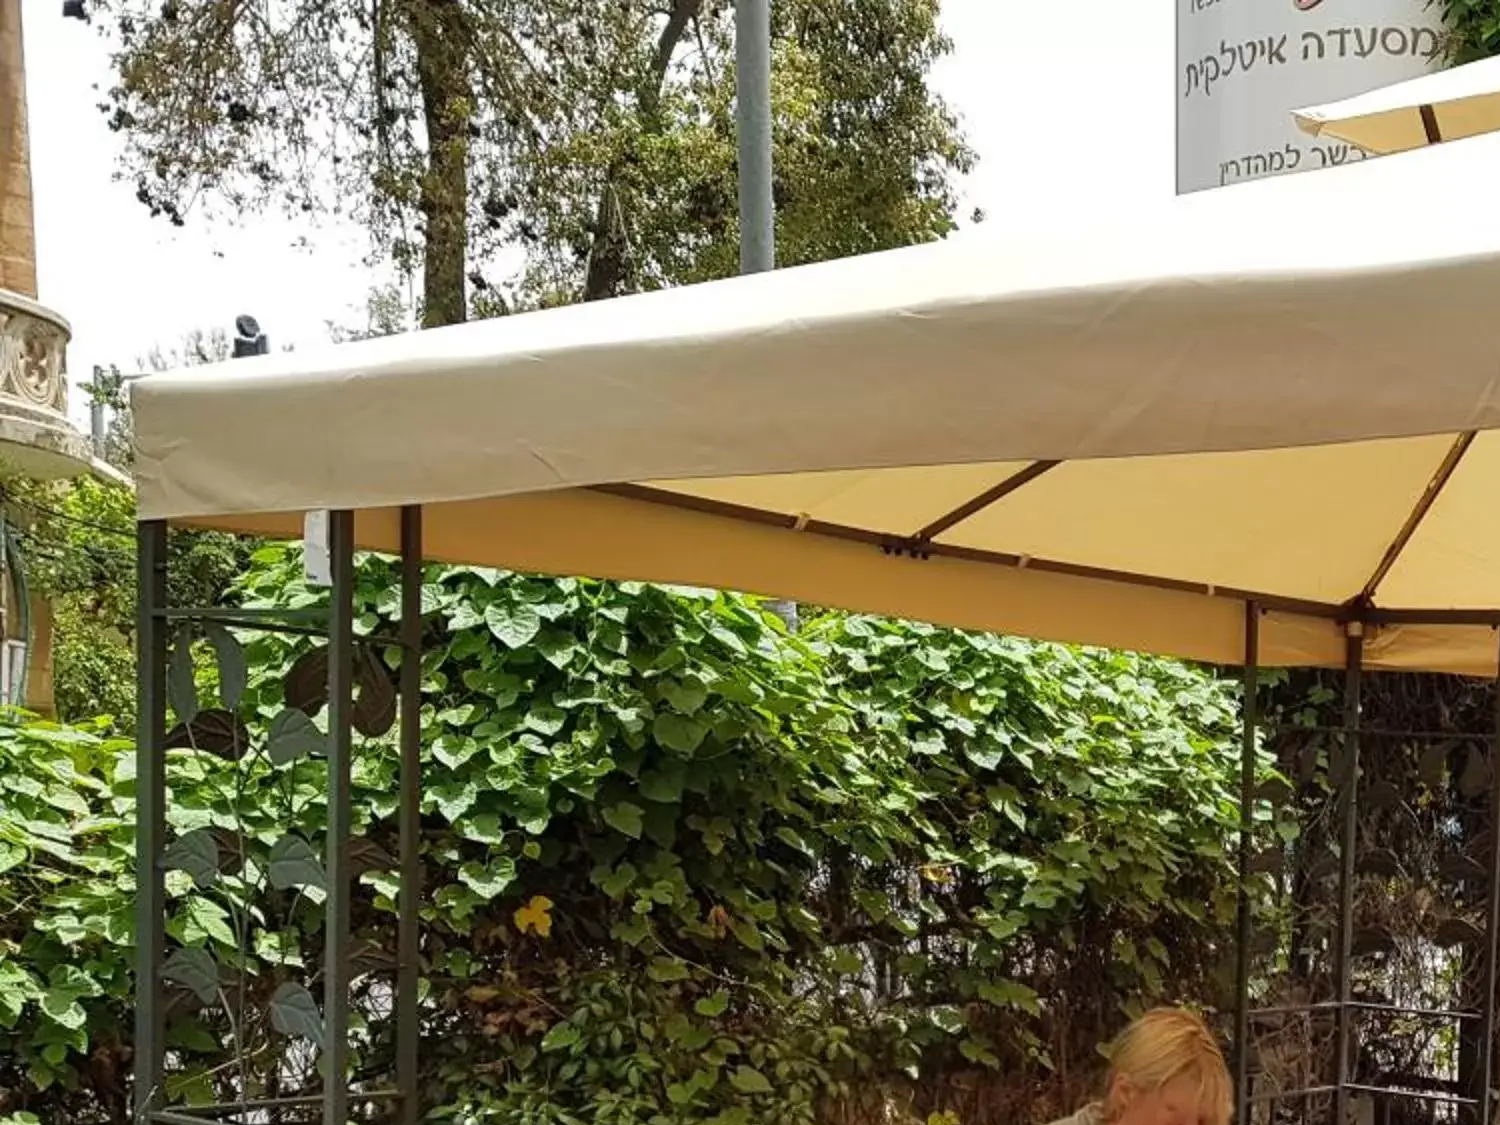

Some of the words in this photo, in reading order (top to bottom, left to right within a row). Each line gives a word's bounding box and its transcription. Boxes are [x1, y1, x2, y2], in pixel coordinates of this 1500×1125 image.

[1185, 34, 1288, 97] איטלקית
[1301, 27, 1438, 61] מסעדה
[1219, 143, 1300, 187] למהדרין
